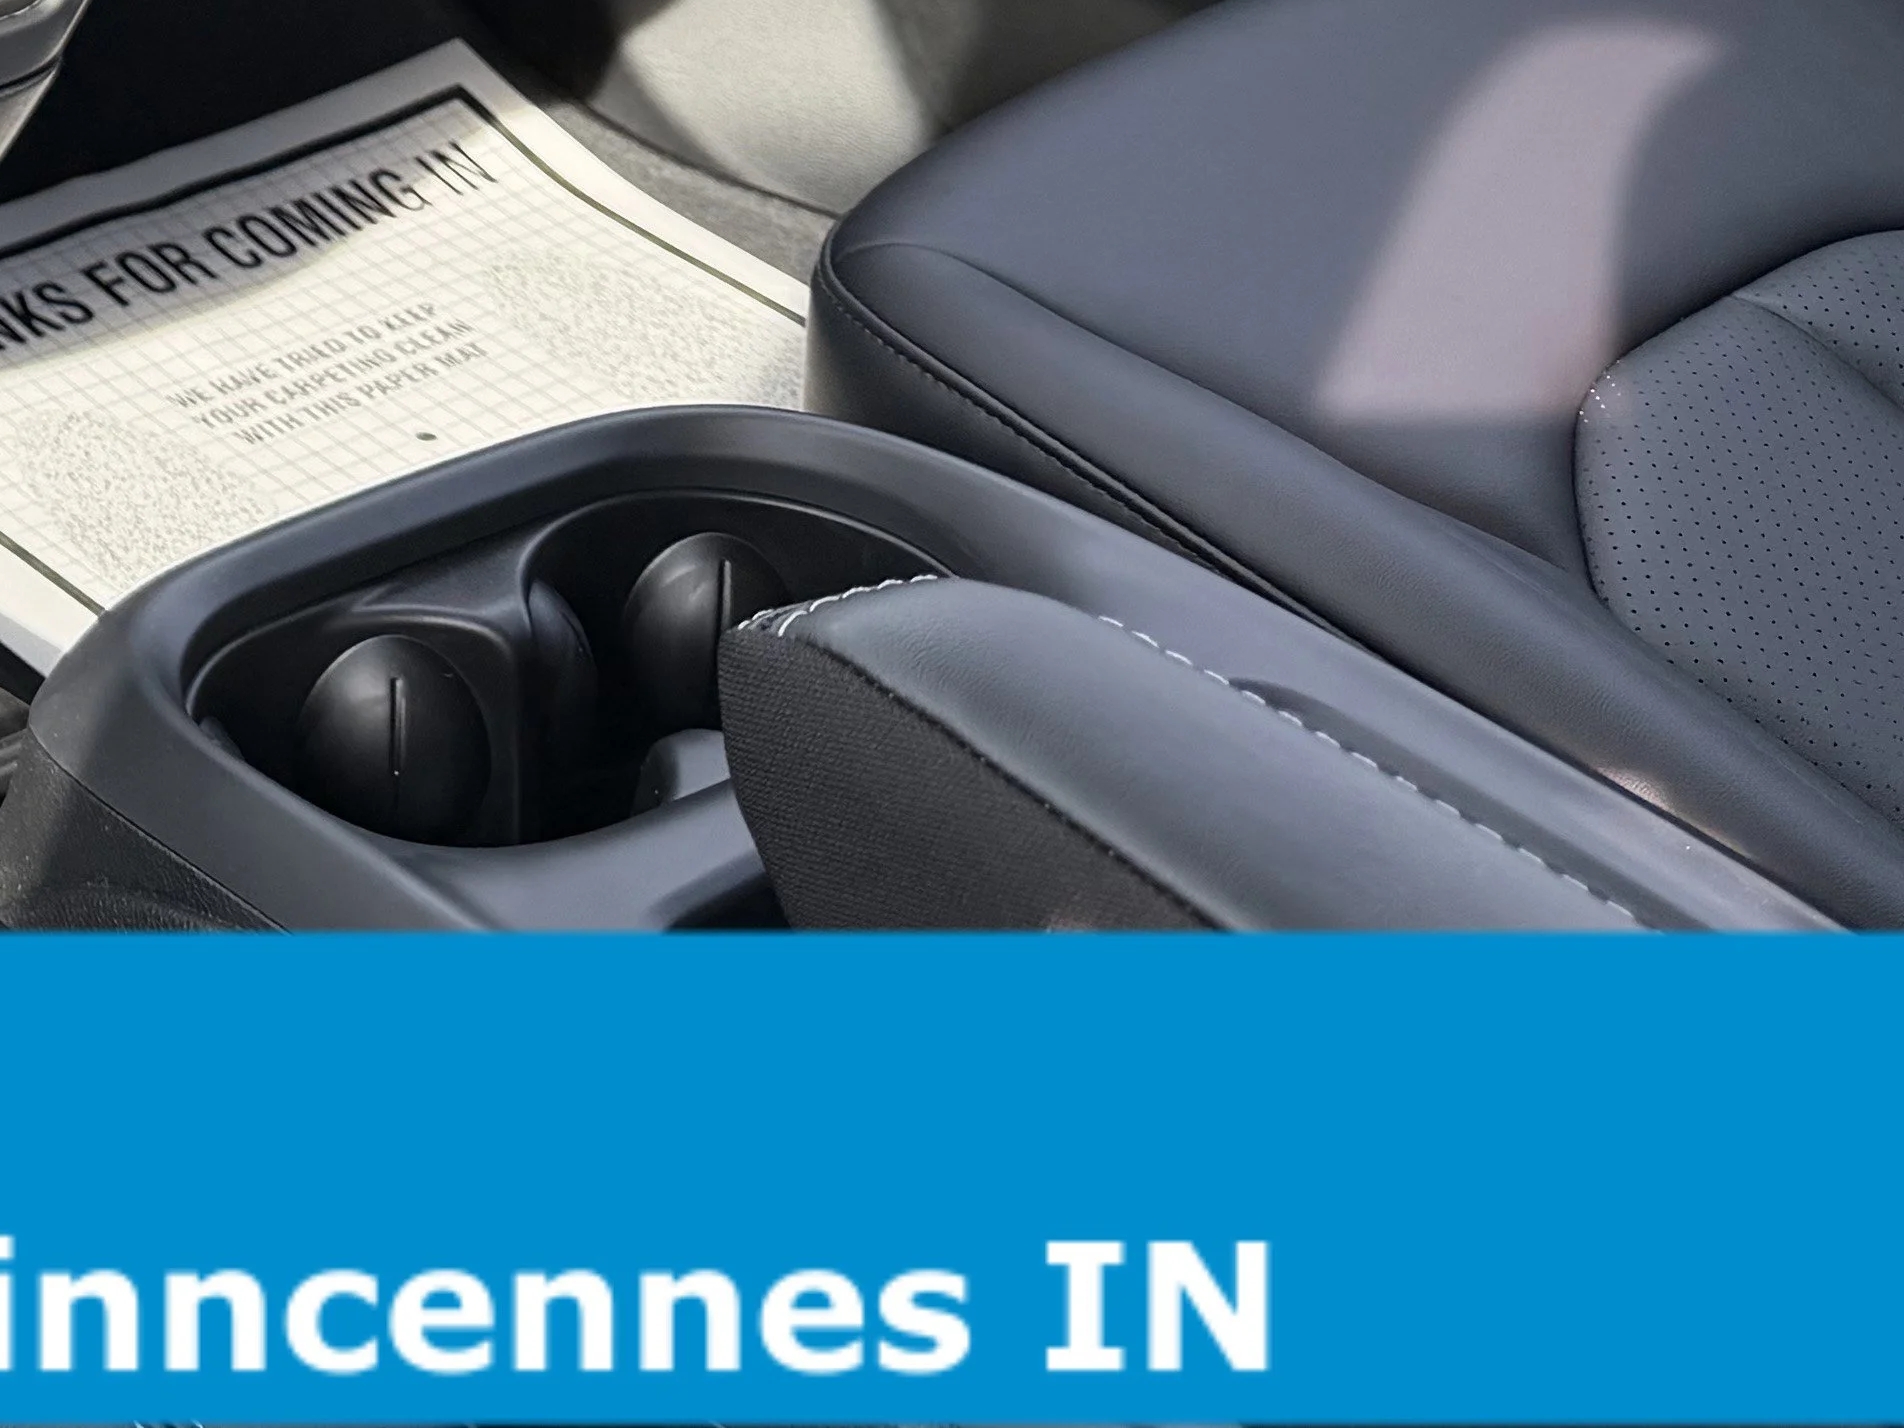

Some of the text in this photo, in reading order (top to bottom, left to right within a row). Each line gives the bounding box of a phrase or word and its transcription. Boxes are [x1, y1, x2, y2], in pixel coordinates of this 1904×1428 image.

[83, 242, 218, 307] FOR
[203, 167, 433, 271] COMING
[415, 141, 498, 196] IN
[166, 388, 213, 410] WE
[209, 362, 278, 396] HAVE
[345, 324, 382, 346] TO
[192, 318, 476, 430] YOUR CARPETING CLEAN
[233, 342, 489, 445] WITH THIS PAPER MAT
